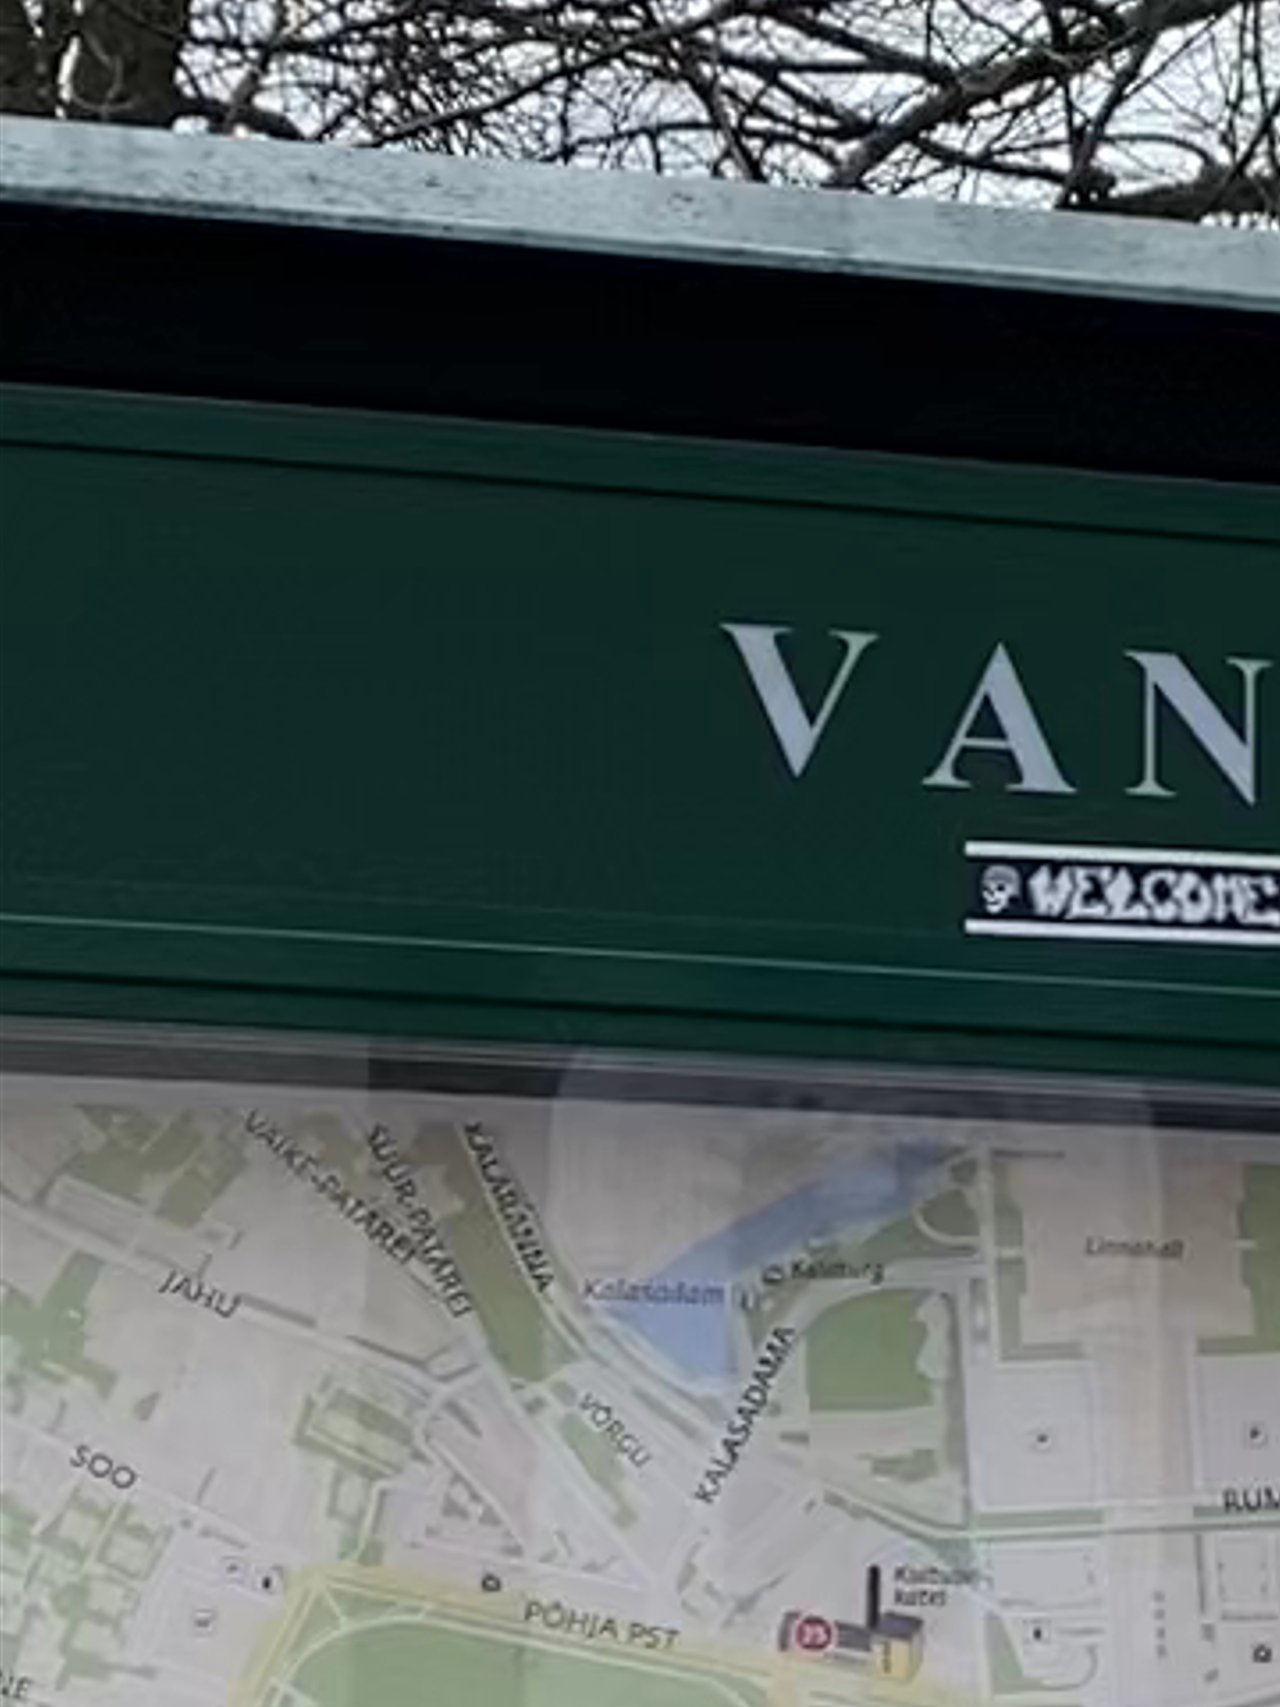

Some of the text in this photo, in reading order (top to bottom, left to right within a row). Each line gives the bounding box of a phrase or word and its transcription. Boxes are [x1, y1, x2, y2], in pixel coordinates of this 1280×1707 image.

[367, 1124, 472, 1319] SUUR-PATAREI
[160, 1270, 241, 1320] JAHU
[694, 1325, 796, 1505] KALASADAMA
[69, 1444, 139, 1491] SOO
[629, 1619, 680, 1649] PST
